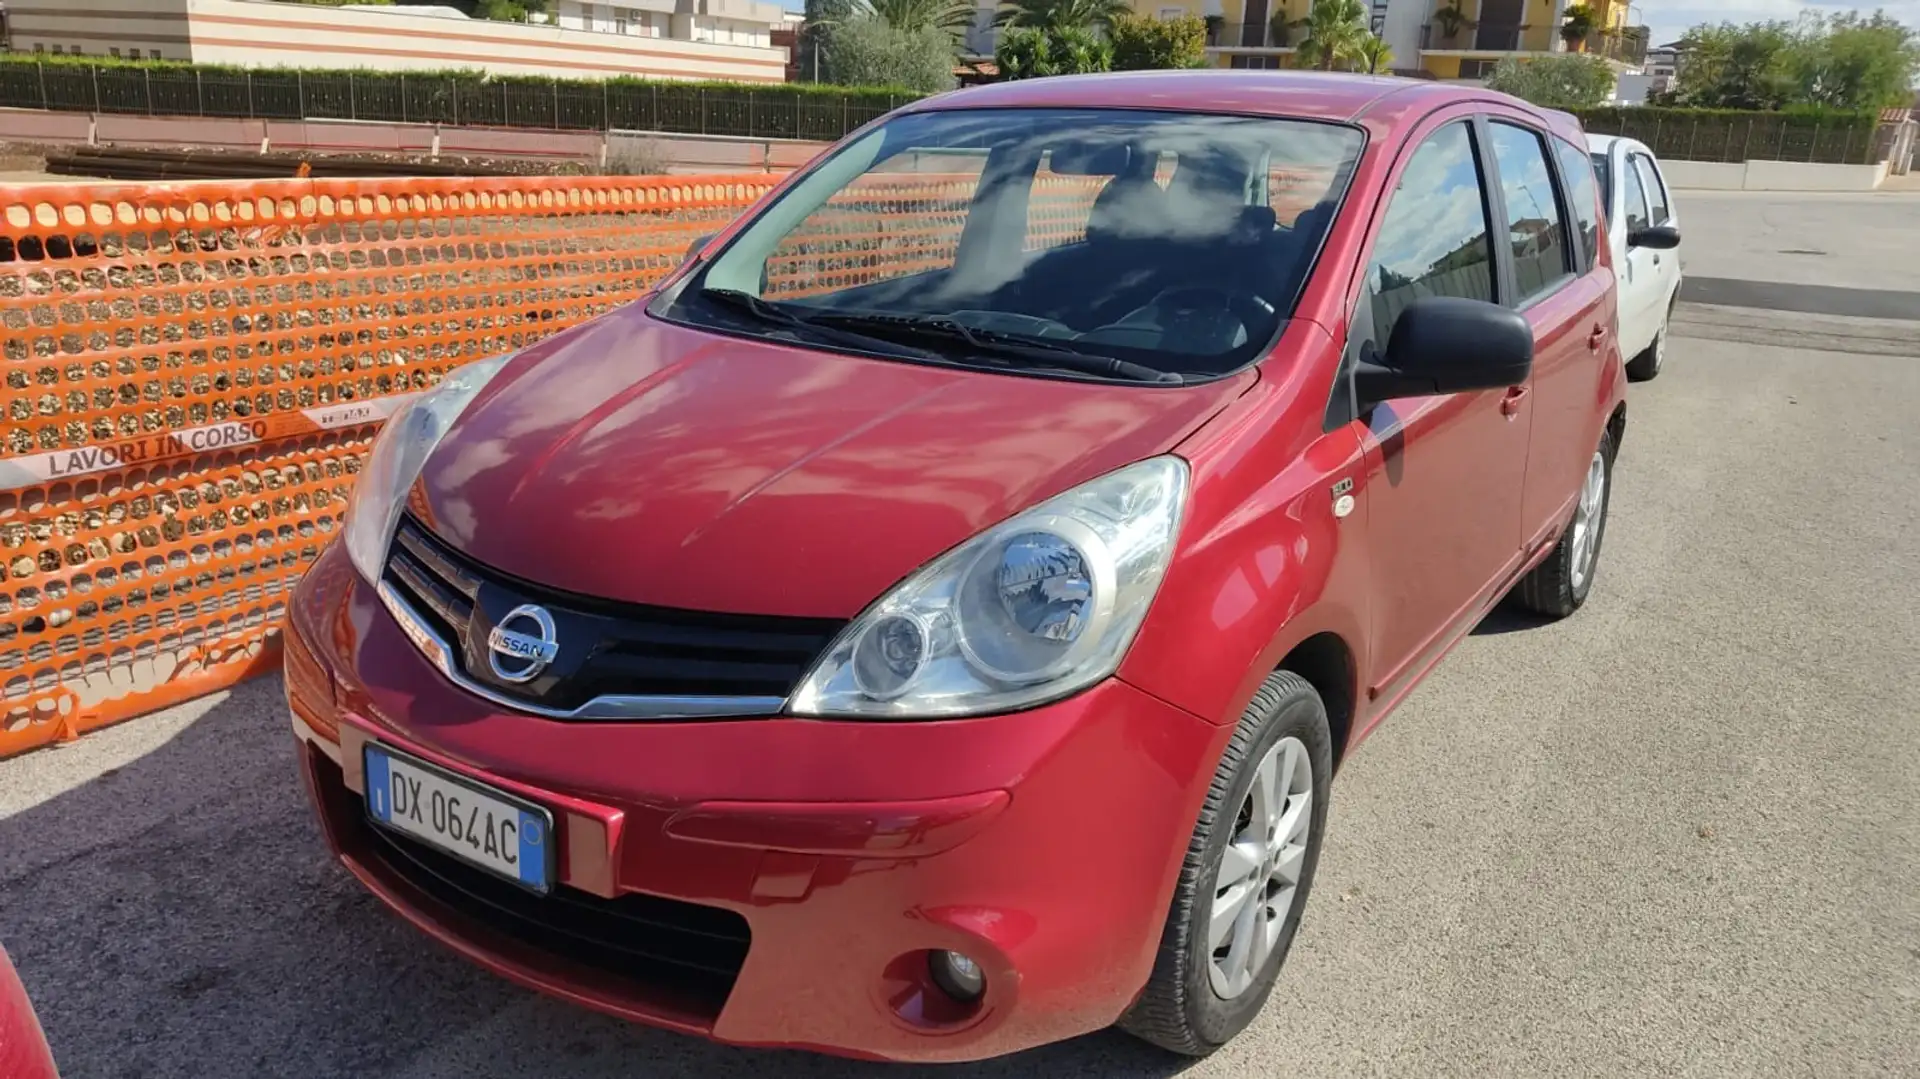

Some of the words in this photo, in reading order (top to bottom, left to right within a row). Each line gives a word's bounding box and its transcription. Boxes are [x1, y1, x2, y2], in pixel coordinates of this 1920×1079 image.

[49, 441, 148, 475] LAVORI
[156, 433, 184, 457] IN
[191, 420, 267, 450] CORSO
[489, 631, 545, 657] NISSAN
[392, 771, 423, 824] DX
[432, 790, 518, 864] 064AC
